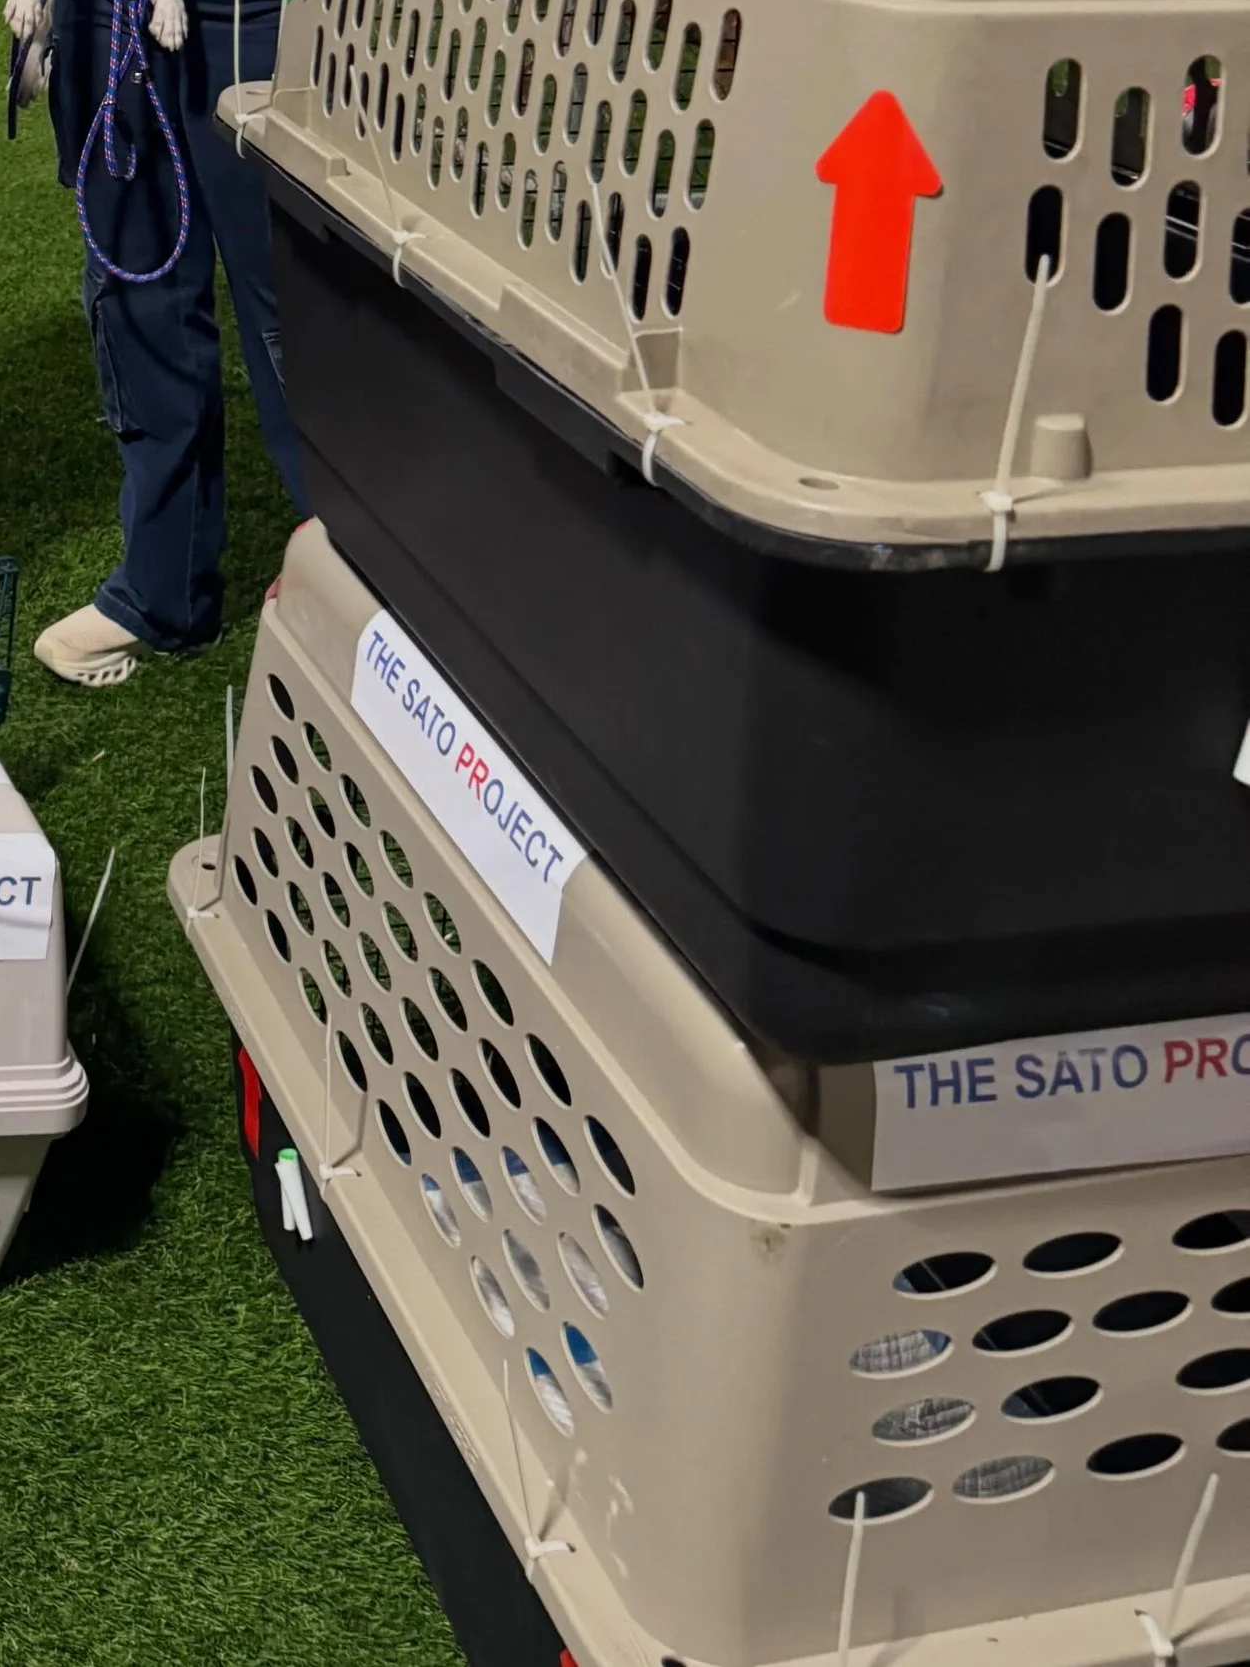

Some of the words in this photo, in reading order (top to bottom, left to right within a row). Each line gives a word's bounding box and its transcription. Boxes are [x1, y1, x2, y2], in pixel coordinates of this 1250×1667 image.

[364, 630, 406, 694] THE
[402, 678, 456, 757] SATO
[454, 742, 564, 884] PROJECT
[893, 1056, 998, 1109] THE
[1014, 1043, 1149, 1100] SATO
